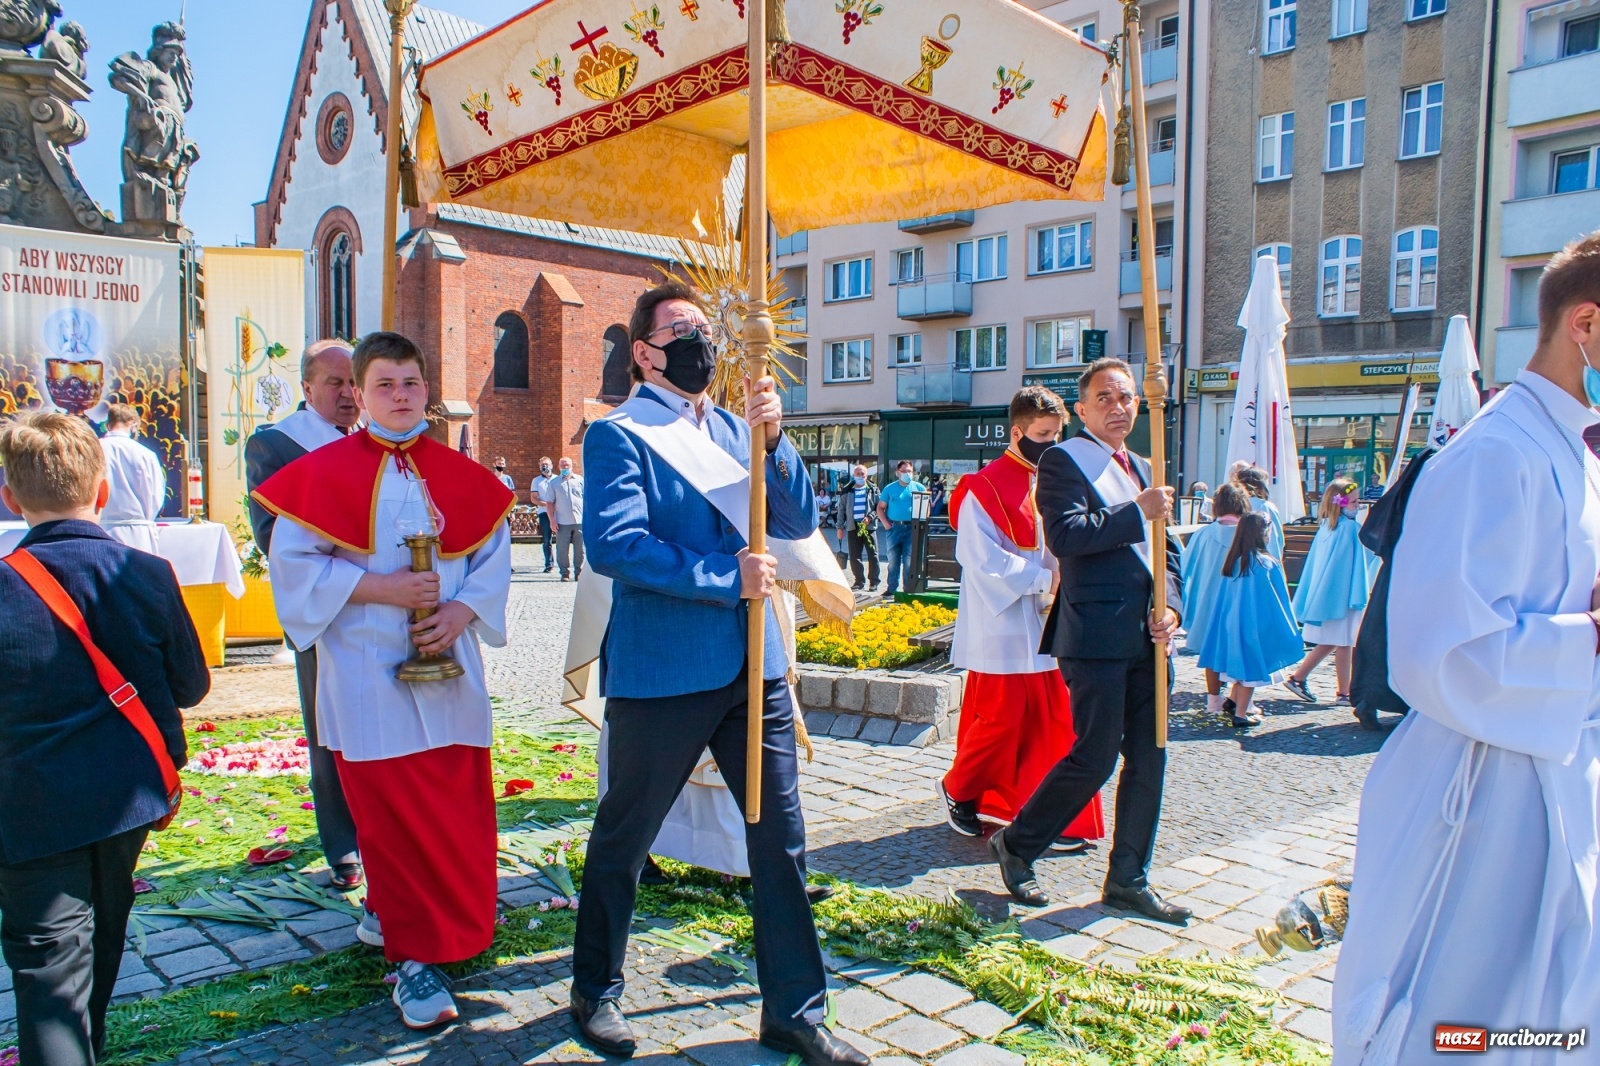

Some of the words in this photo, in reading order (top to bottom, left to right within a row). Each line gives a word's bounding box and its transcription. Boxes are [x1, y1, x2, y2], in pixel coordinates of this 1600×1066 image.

[19, 247, 50, 269] ABY
[55, 251, 124, 276] WSZYSCY
[2, 272, 87, 299] STANOWILI
[92, 281, 140, 303] JEDNO
[1363, 365, 1405, 375] STEFCZYK
[787, 428, 855, 451] STELLA
